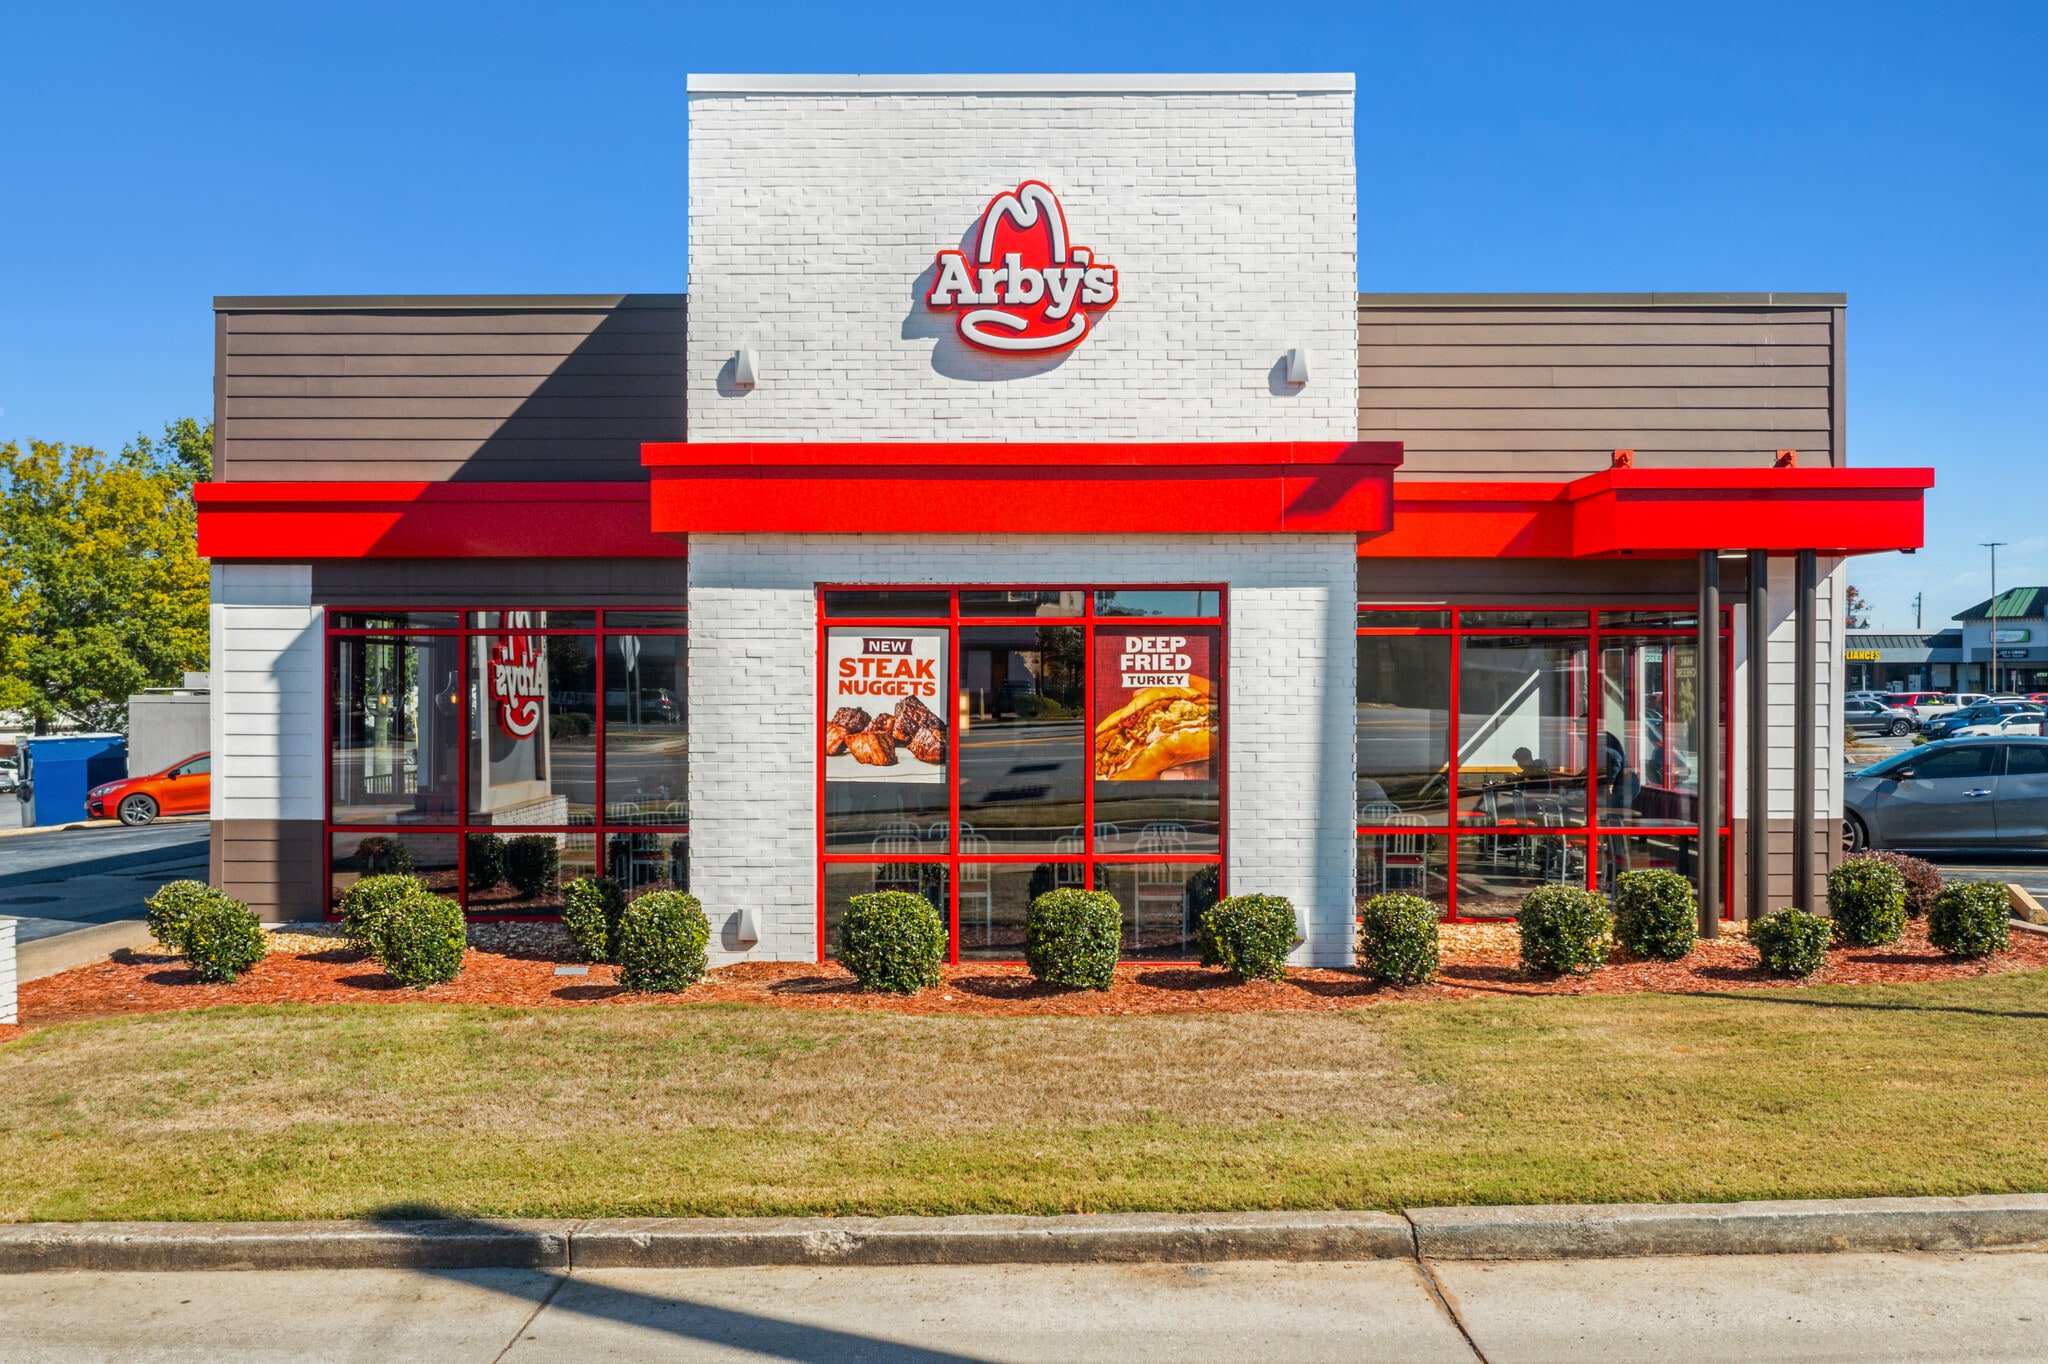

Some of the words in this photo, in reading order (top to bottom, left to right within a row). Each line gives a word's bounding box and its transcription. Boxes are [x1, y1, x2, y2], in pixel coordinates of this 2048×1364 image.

[931, 250, 1114, 319] Arby's
[868, 641, 907, 653] NEW
[1125, 636, 1187, 653] DEEP
[1120, 654, 1192, 671] FRIED
[1844, 650, 1881, 660] LIANCES
[838, 657, 936, 680] STEAK
[838, 679, 936, 697] NUGGETS
[1127, 675, 1184, 685] TURKEY
